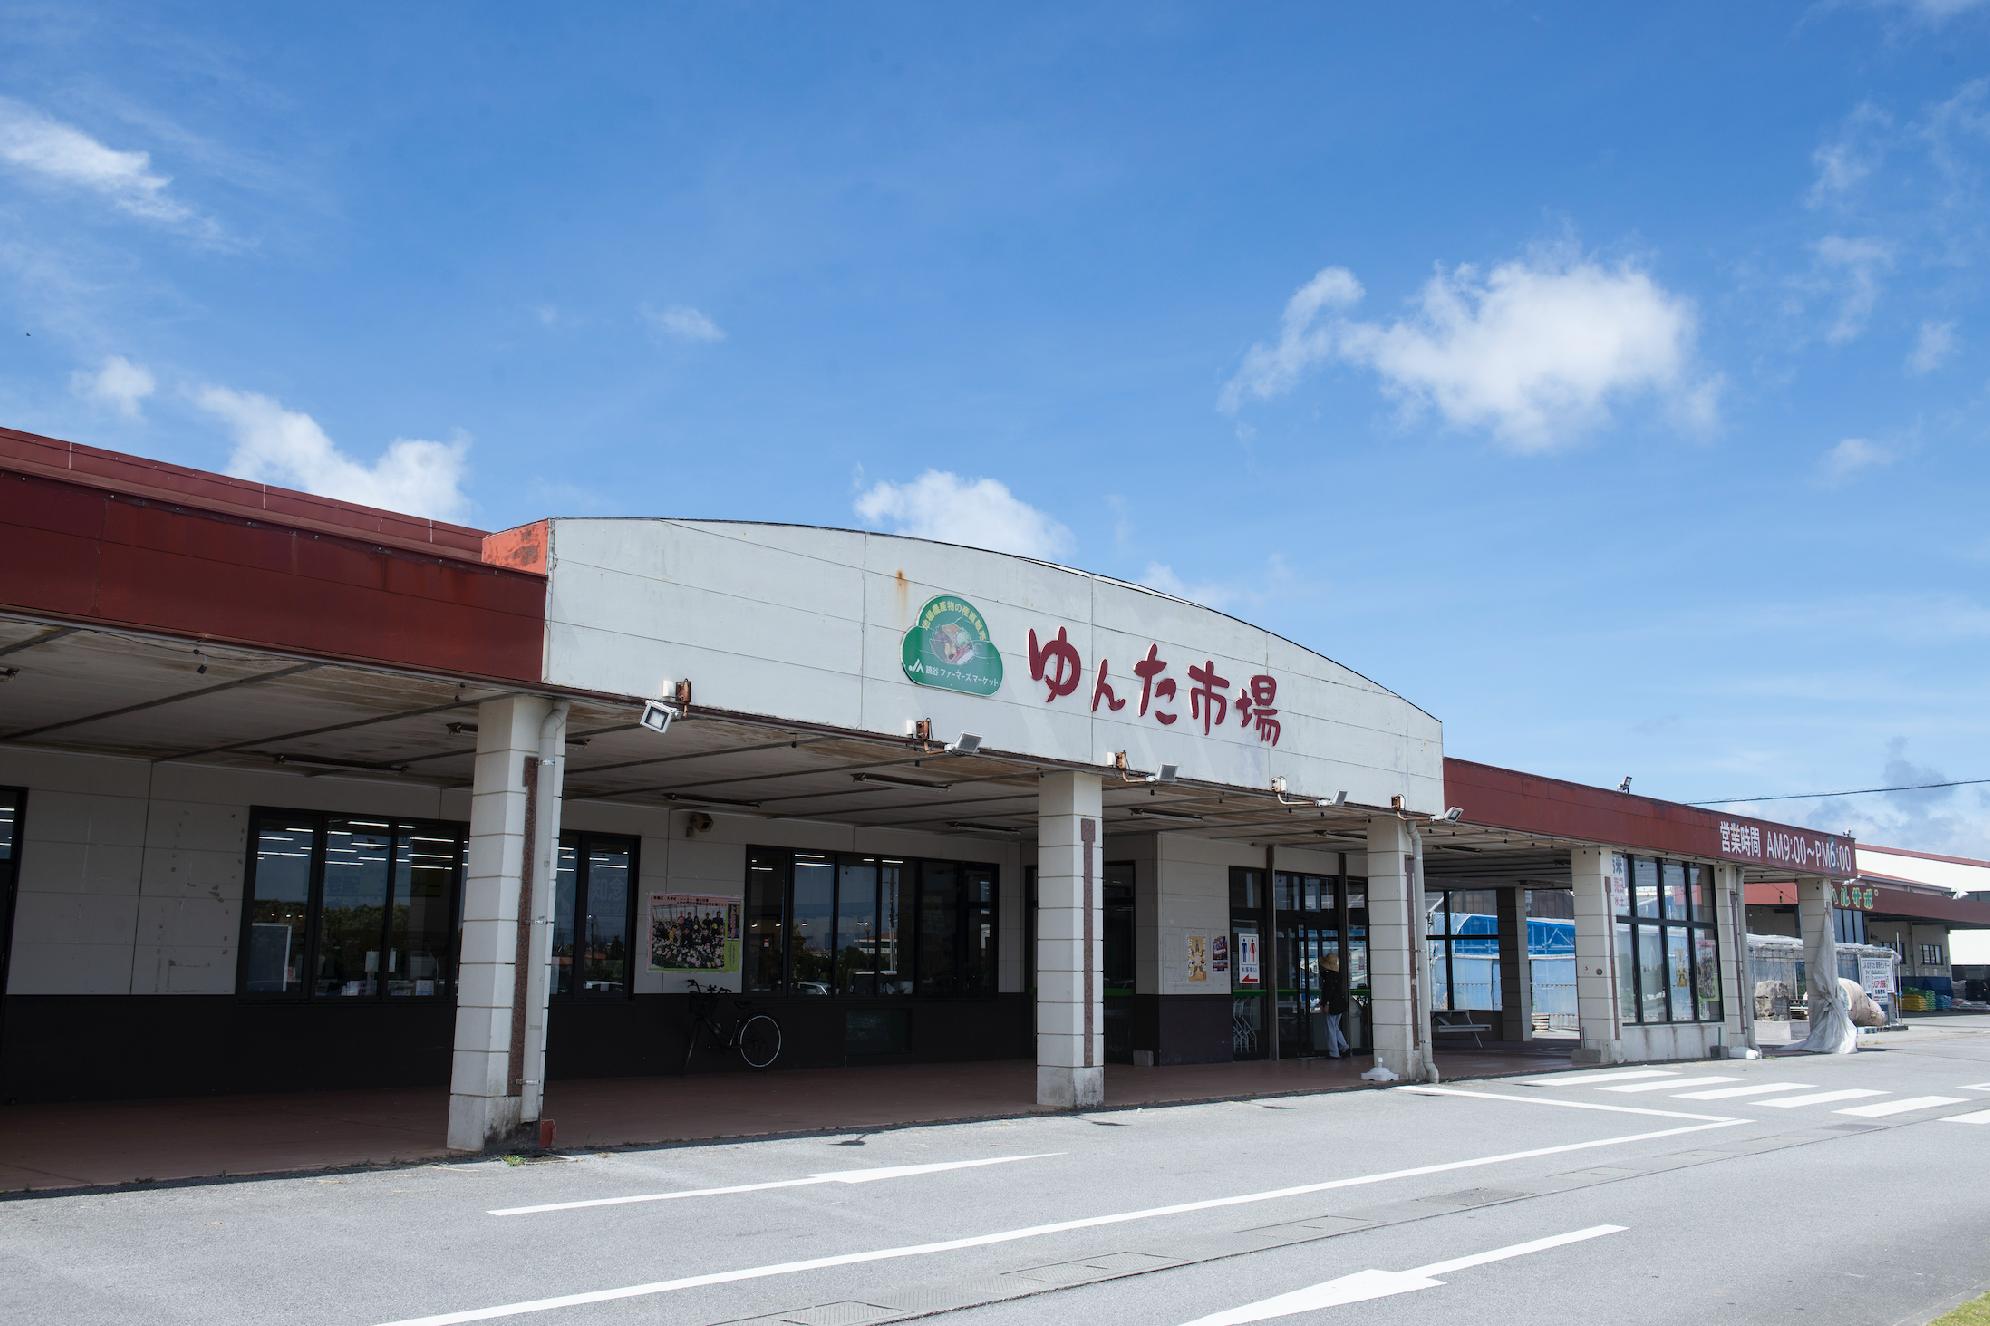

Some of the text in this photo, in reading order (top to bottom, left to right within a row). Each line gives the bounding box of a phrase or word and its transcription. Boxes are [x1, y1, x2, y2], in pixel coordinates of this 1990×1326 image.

[1027, 625, 1281, 747] ゆんた市場
[1719, 820, 1761, 858] 営業時間
